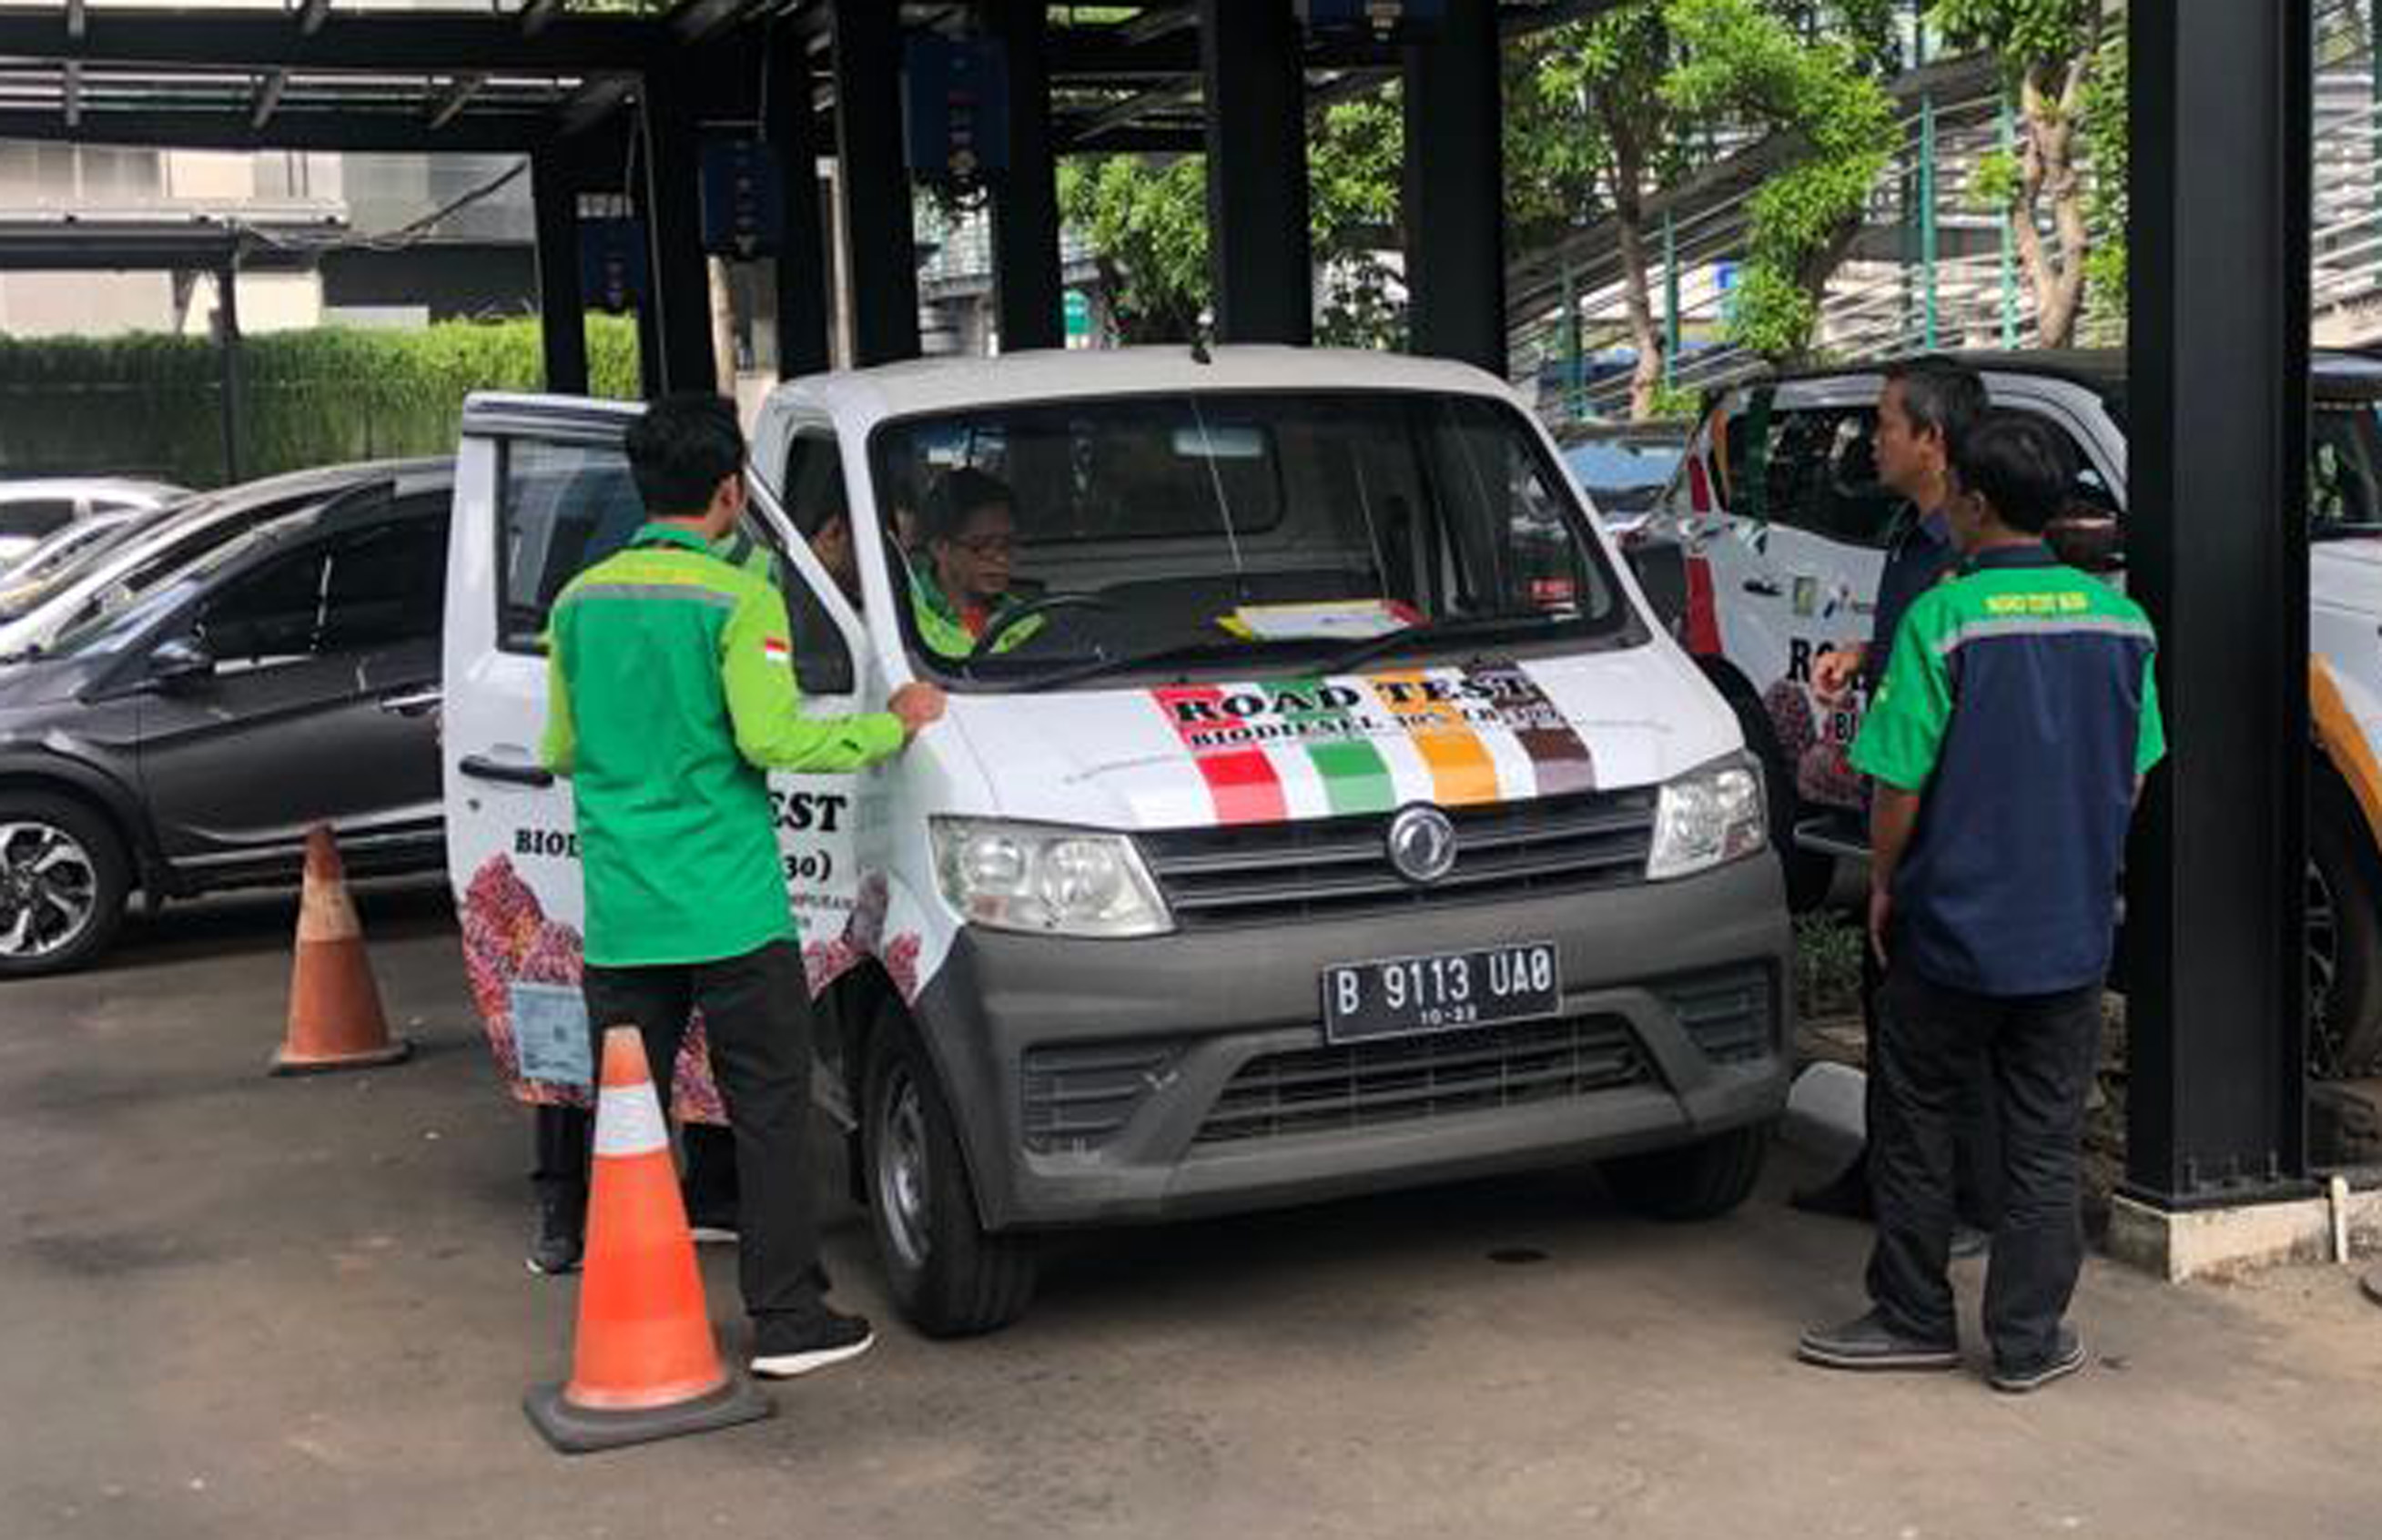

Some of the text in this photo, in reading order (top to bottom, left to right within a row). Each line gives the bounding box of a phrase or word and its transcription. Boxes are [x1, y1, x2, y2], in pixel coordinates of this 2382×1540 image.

[1175, 674, 1542, 722] ROAD TEST
[768, 790, 847, 832] EST
[1337, 970, 1359, 1014] B
[1384, 957, 1469, 1008] 9113
